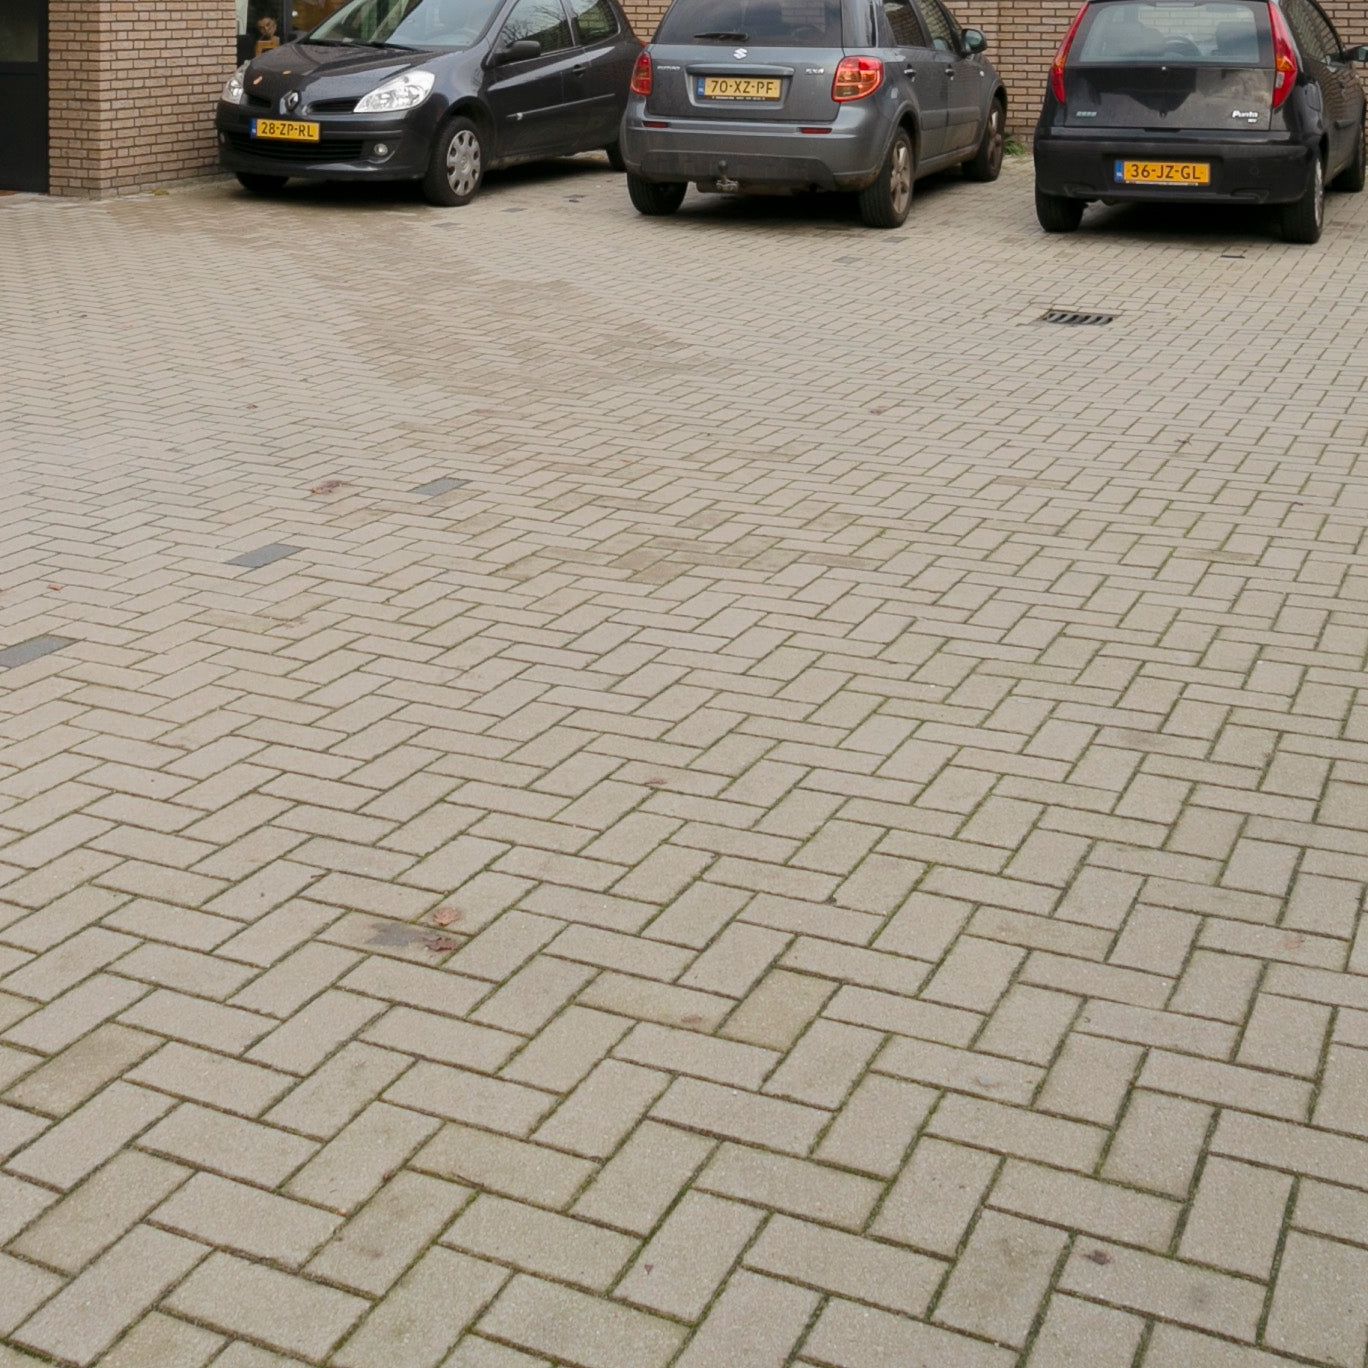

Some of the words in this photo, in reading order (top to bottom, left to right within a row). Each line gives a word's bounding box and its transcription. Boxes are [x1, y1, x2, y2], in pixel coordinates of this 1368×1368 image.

[710, 79, 774, 94] 70-XZ-PF
[261, 121, 314, 138] 28-ZP-RL
[1131, 163, 1201, 180] 36-JZ-GL
